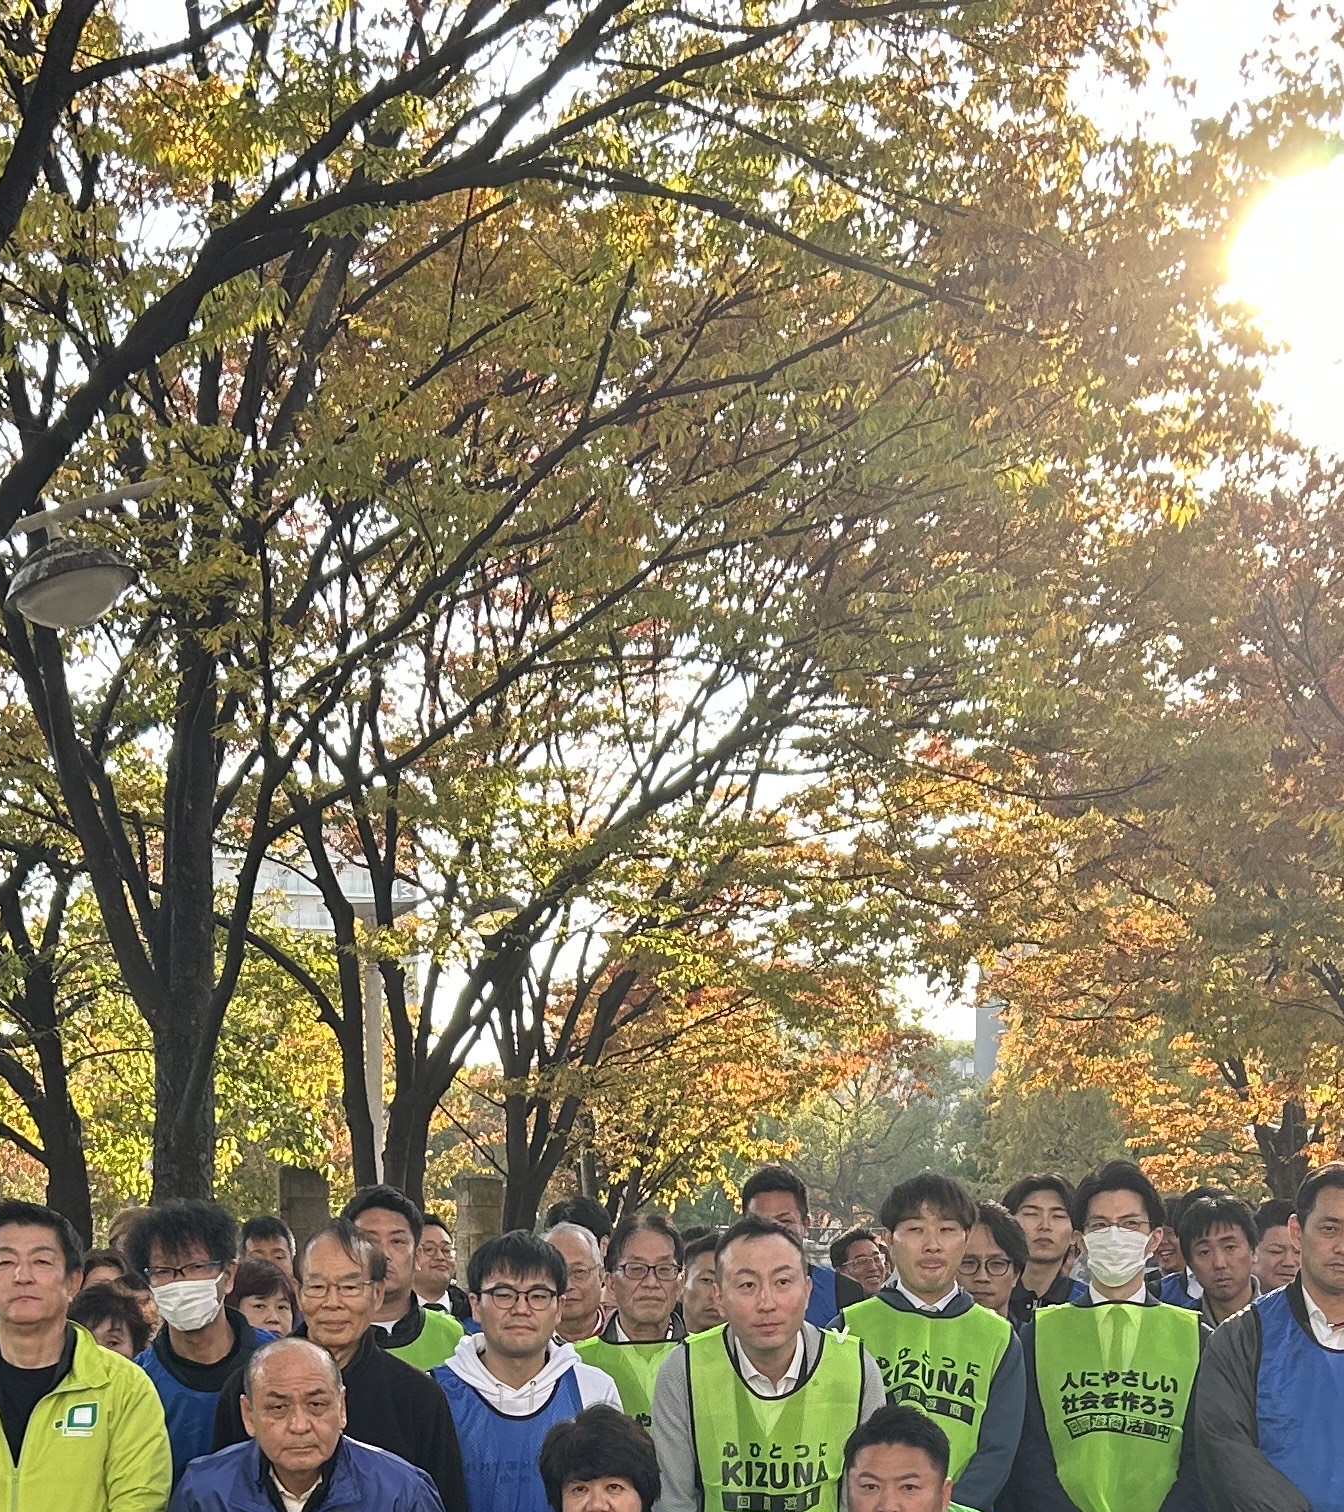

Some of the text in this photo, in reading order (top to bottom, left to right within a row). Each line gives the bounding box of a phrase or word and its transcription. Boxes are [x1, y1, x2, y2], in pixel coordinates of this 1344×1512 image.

[1059, 1369, 1178, 1394] 人にやさしい
[1061, 1391, 1174, 1418] 社会を作ろう
[721, 1460, 829, 1489] KIZUNA
